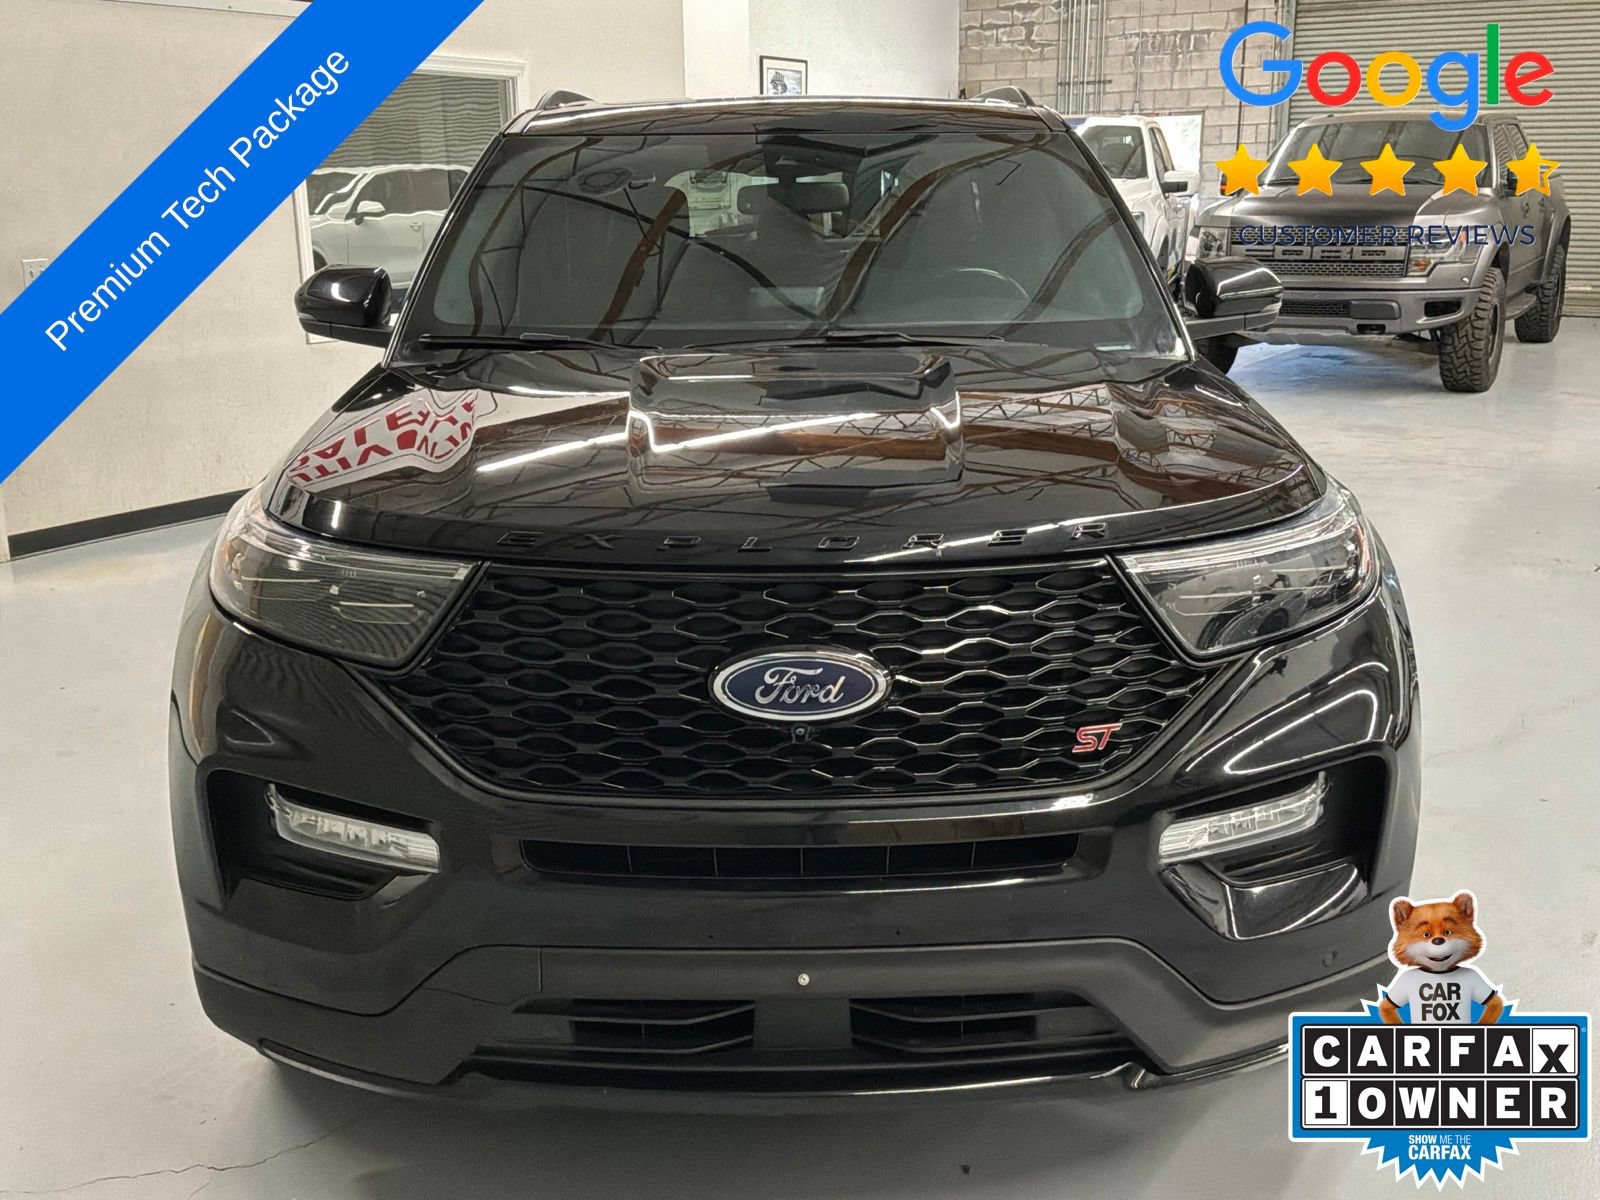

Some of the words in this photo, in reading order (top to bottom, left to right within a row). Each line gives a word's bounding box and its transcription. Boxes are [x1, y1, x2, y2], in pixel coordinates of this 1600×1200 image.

[496, 522, 1108, 553] EXPLORER
[754, 666, 846, 705] Ford
[1072, 722, 1123, 753] ST
